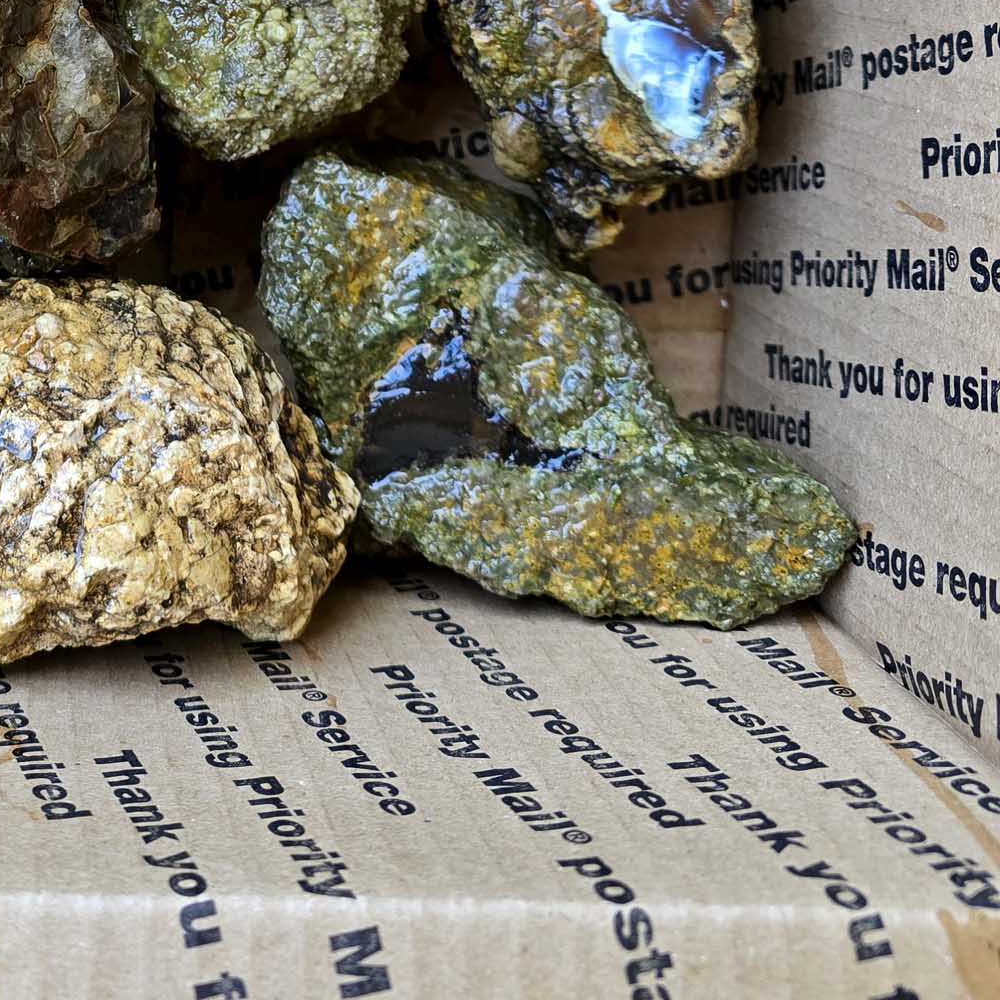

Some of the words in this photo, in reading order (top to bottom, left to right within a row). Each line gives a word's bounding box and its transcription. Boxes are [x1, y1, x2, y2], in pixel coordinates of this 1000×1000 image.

[861, 29, 974, 90] postage
[730, 254, 784, 294] using
[790, 249, 880, 298] Priority
[886, 245, 960, 291] Mail®
[727, 404, 811, 448] required
[763, 343, 834, 389] Thank
[838, 359, 885, 399] you
[893, 357, 935, 403] for
[143, 652, 195, 692] for
[173, 694, 255, 769] using
[231, 775, 358, 901] Priority
[300, 708, 418, 817] Service
[368, 663, 492, 760] Priority
[472, 767, 594, 845] Mail®
[408, 606, 540, 702] postage
[527, 707, 707, 830] required
[736, 636, 857, 698] Mail®
[842, 705, 1000, 814] Service
[875, 640, 985, 738] Priority
[93, 749, 186, 845] Thank
[143, 849, 225, 950] you
[649, 652, 719, 690] for
[706, 696, 830, 771] using
[817, 777, 1000, 910] Priority
[666, 752, 810, 854] Thank
[783, 860, 896, 965] you
